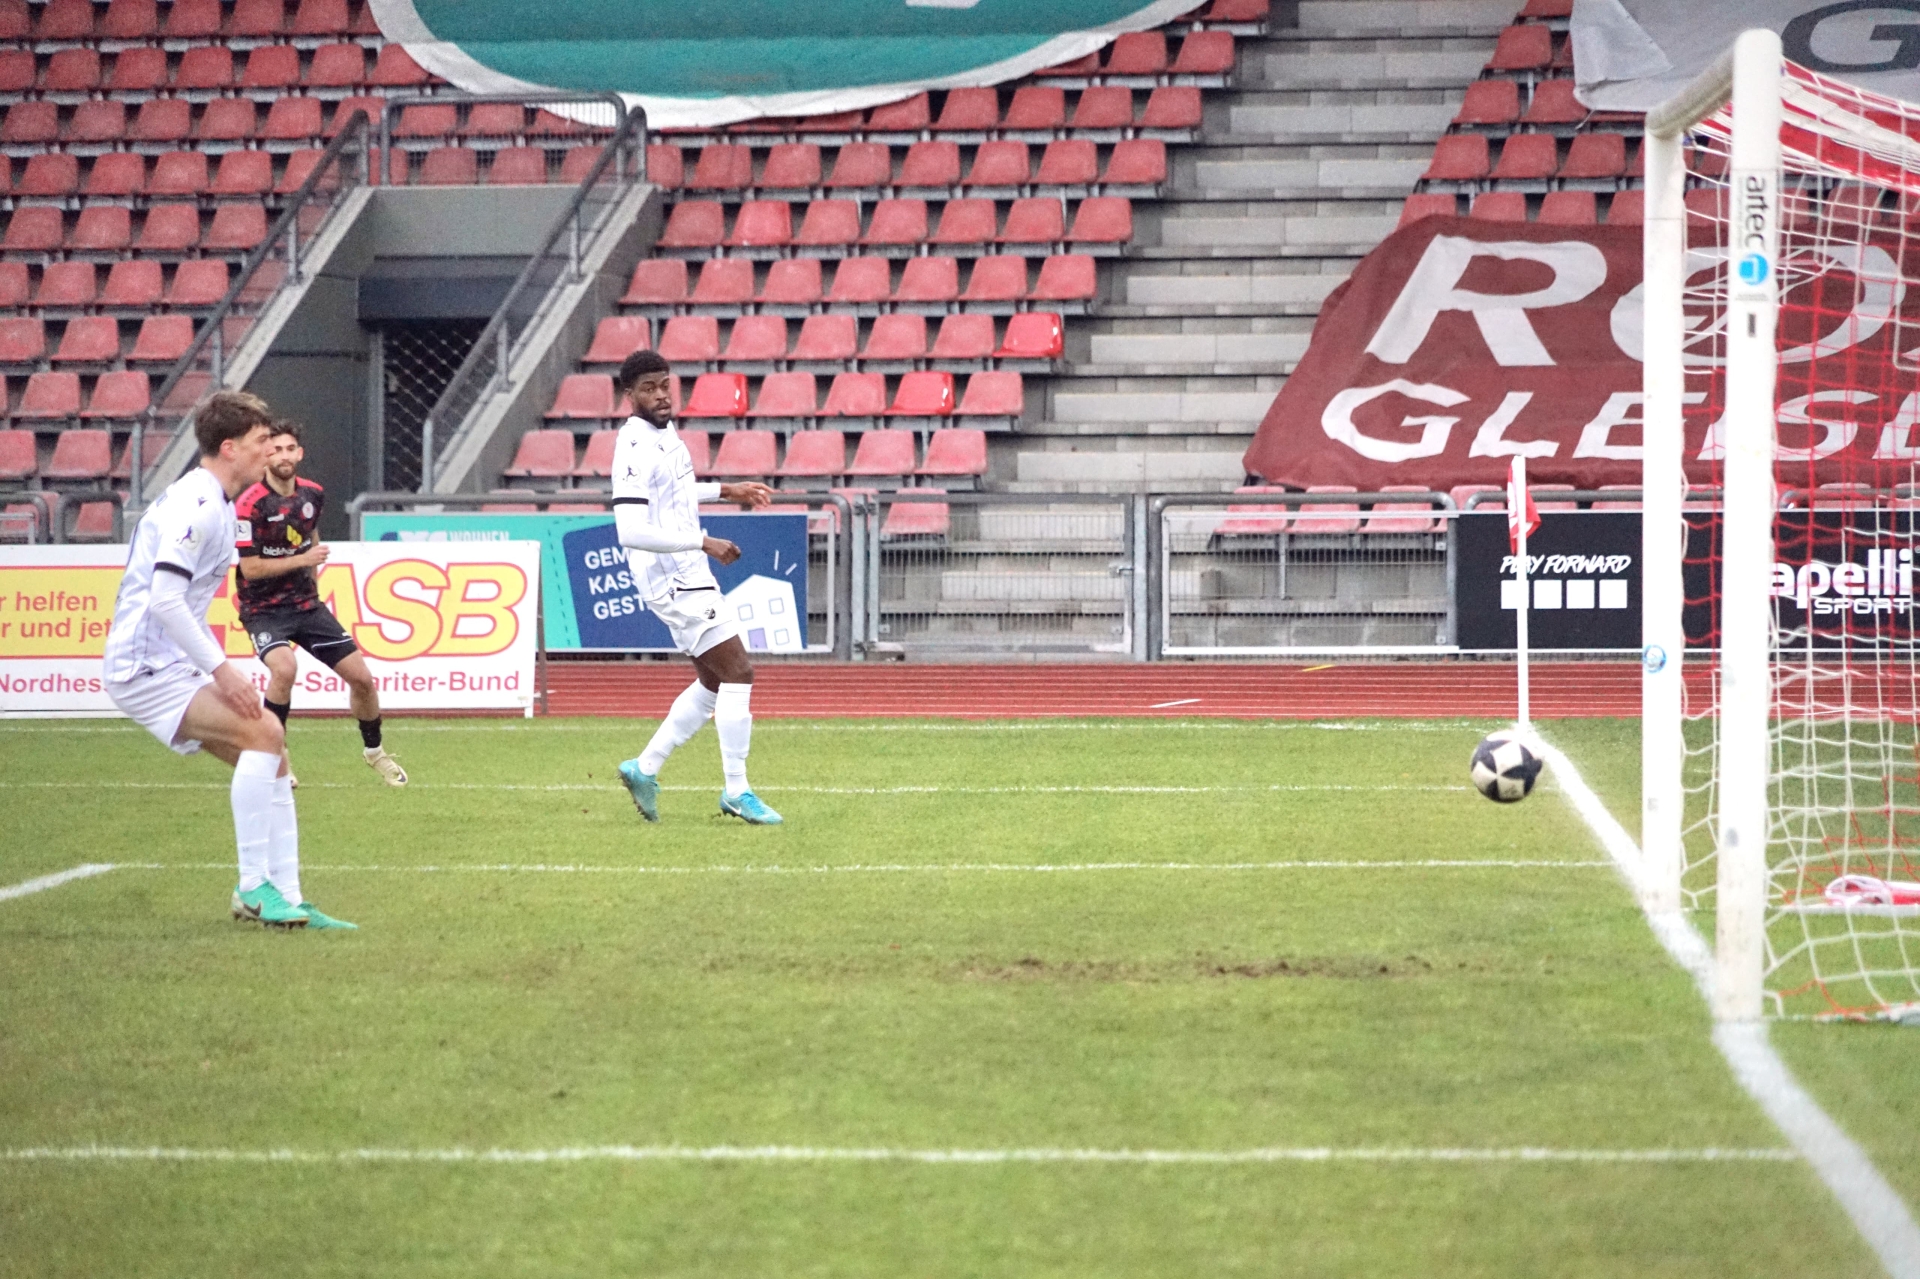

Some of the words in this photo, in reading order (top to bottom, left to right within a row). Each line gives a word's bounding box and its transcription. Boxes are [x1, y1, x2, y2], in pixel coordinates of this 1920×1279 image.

[1744, 175, 1769, 251] artec
[584, 546, 629, 570] GEM
[1542, 554, 1632, 574] FORWARD
[1769, 548, 1912, 609] apelli
[15, 591, 98, 611] helfen
[593, 594, 651, 620] GEST
[1813, 598, 1911, 614] SPORT
[20, 617, 71, 638] und
[79, 617, 112, 643] jet
[0, 673, 108, 693] Nordhes
